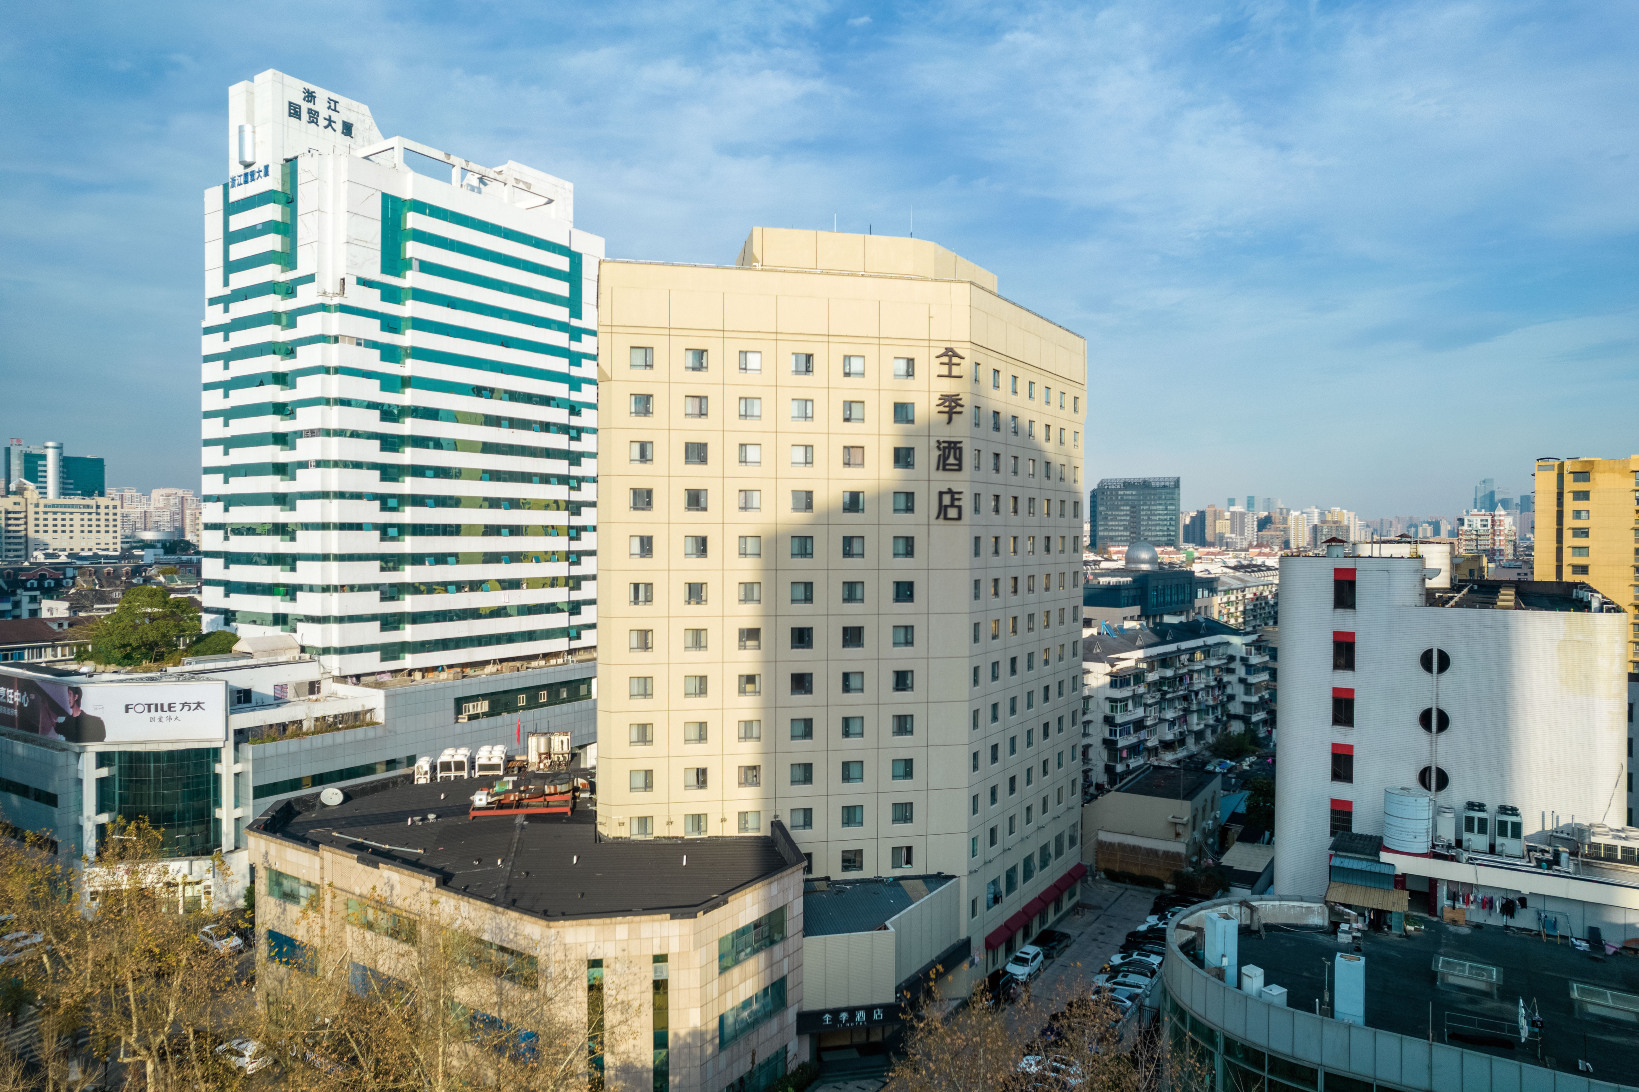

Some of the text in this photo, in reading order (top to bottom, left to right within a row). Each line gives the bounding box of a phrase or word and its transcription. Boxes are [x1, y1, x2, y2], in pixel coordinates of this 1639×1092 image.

[302, 87, 340, 113] 浙江
[288, 100, 354, 139] 国贸大厦
[935, 347, 966, 521] 全季酒店
[124, 701, 206, 714] FOTILE 方太
[822, 1008, 884, 1025] 全季酒店
